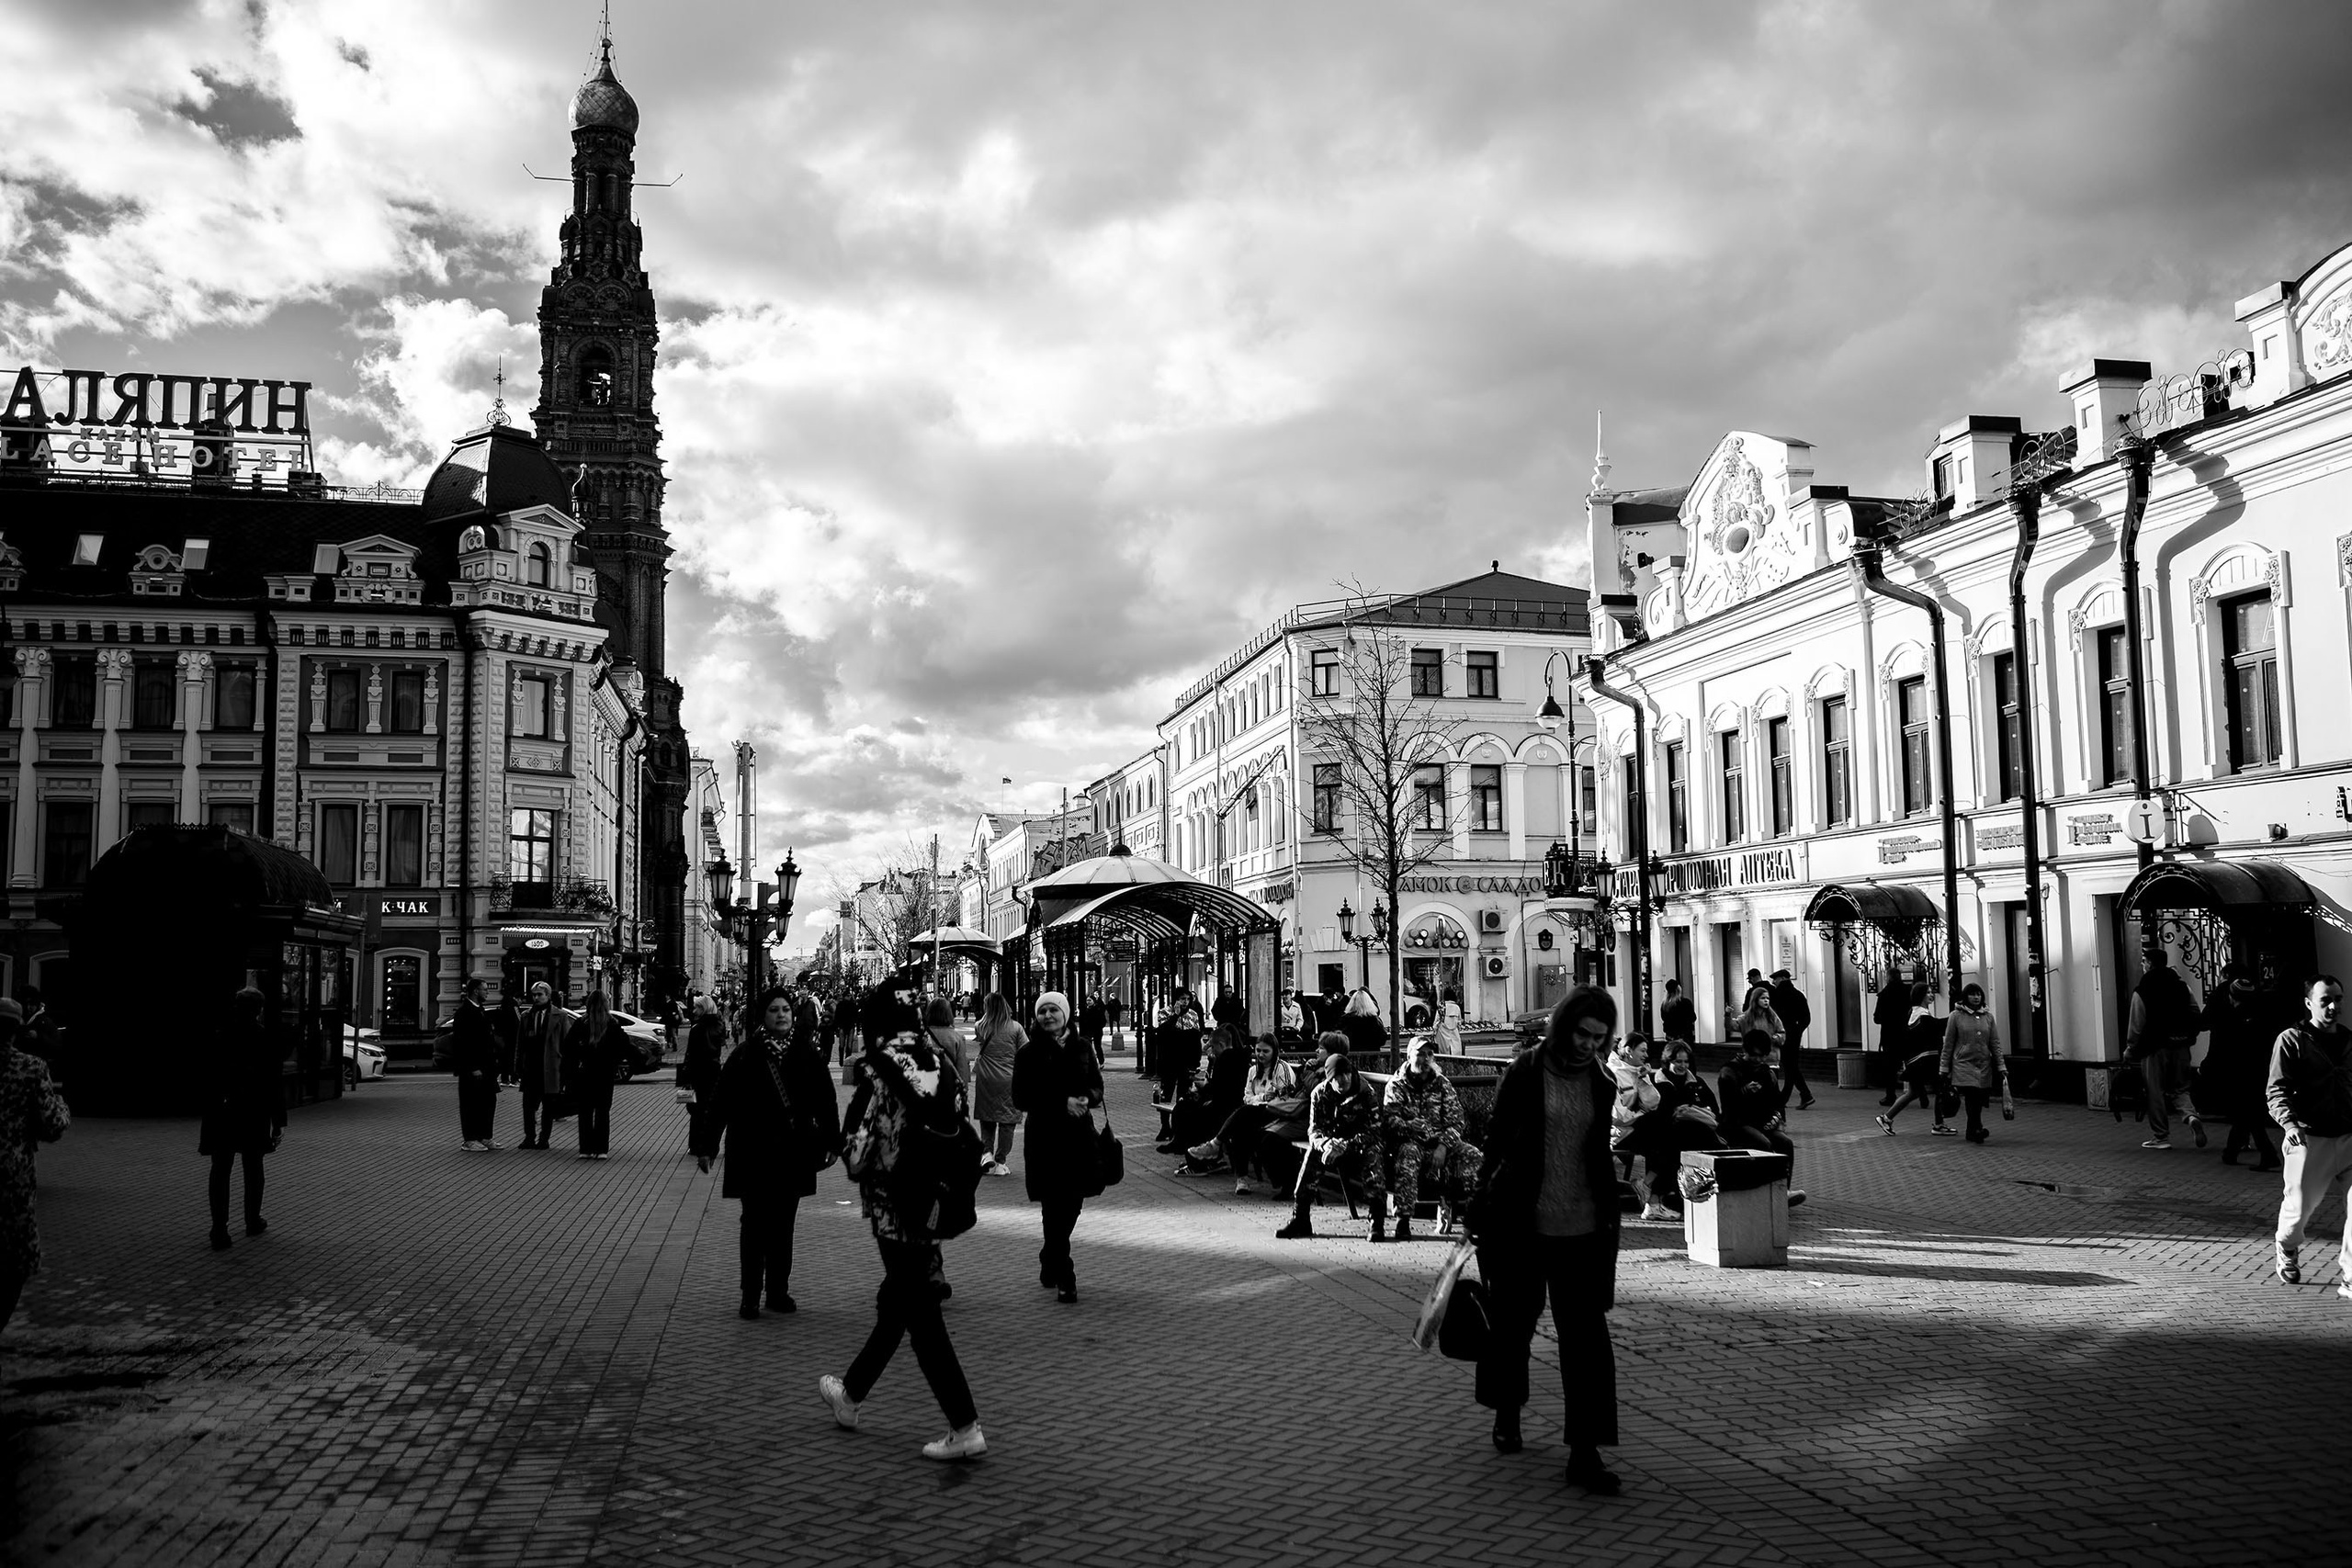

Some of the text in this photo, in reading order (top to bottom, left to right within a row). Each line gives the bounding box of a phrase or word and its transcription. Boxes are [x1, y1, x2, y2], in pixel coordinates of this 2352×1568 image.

[0, 366, 311, 434] АЛЯПИН
[80, 427, 160, 444] KAZAN
[0, 436, 309, 472] LACE HOTEL
[1398, 875, 1543, 897] АМОК СЛАДО
[1612, 869, 1640, 898] СТАРА
[1740, 849, 1796, 885] АПТЕКА
[2263, 966, 2275, 979] 24
